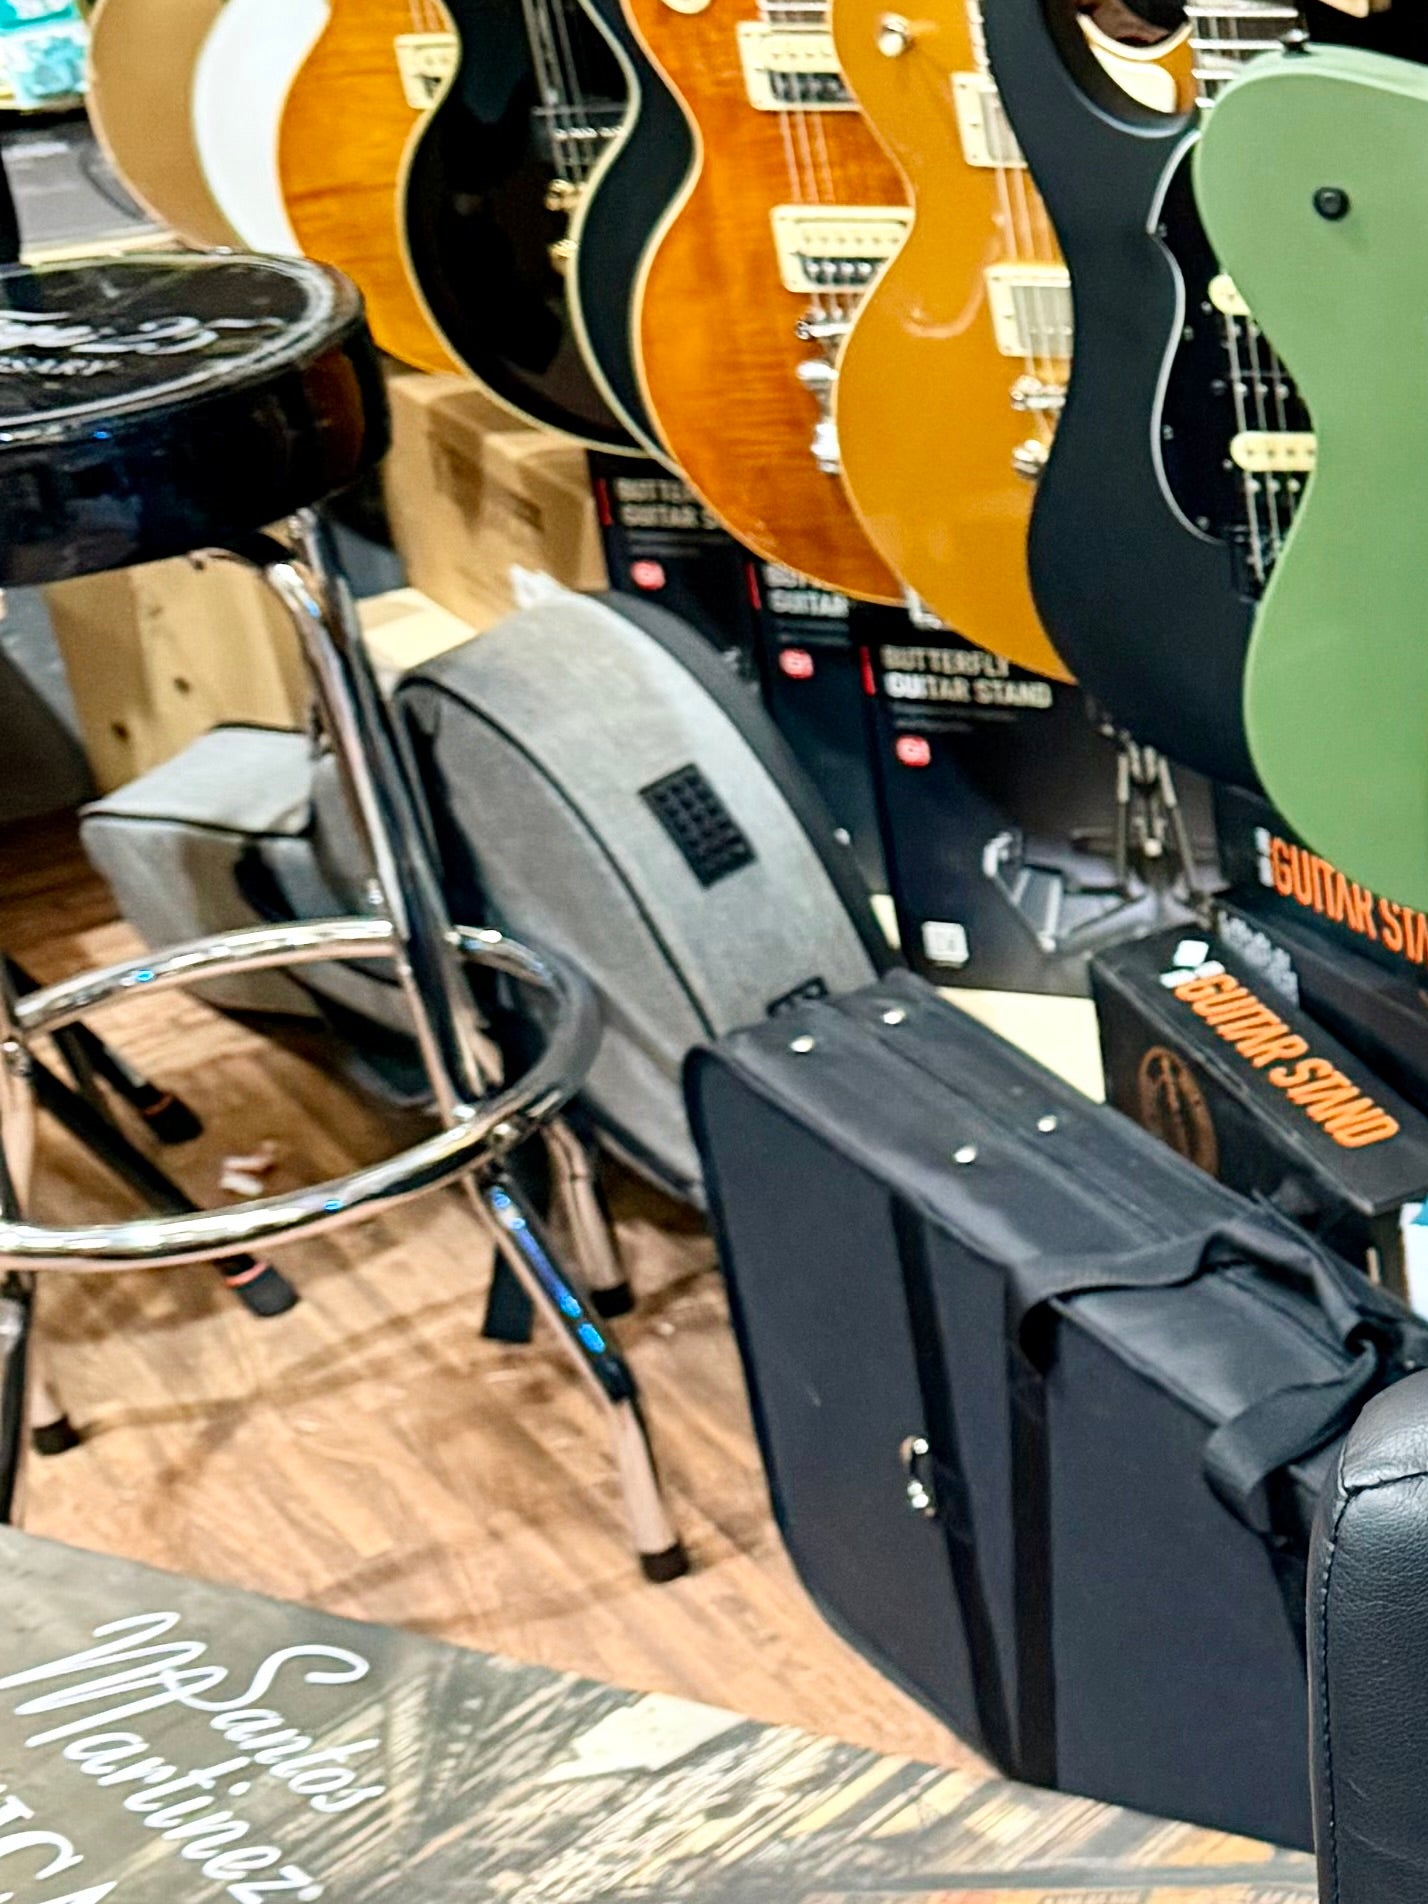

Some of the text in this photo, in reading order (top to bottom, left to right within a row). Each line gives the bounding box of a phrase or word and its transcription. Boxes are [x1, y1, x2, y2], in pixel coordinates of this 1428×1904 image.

[884, 672, 1054, 709] GUITAR STAND
[1270, 836, 1378, 941] GUITAR
[1173, 972, 1400, 1149] GUITAR STAND
[163, 1643, 386, 1814] Santos
